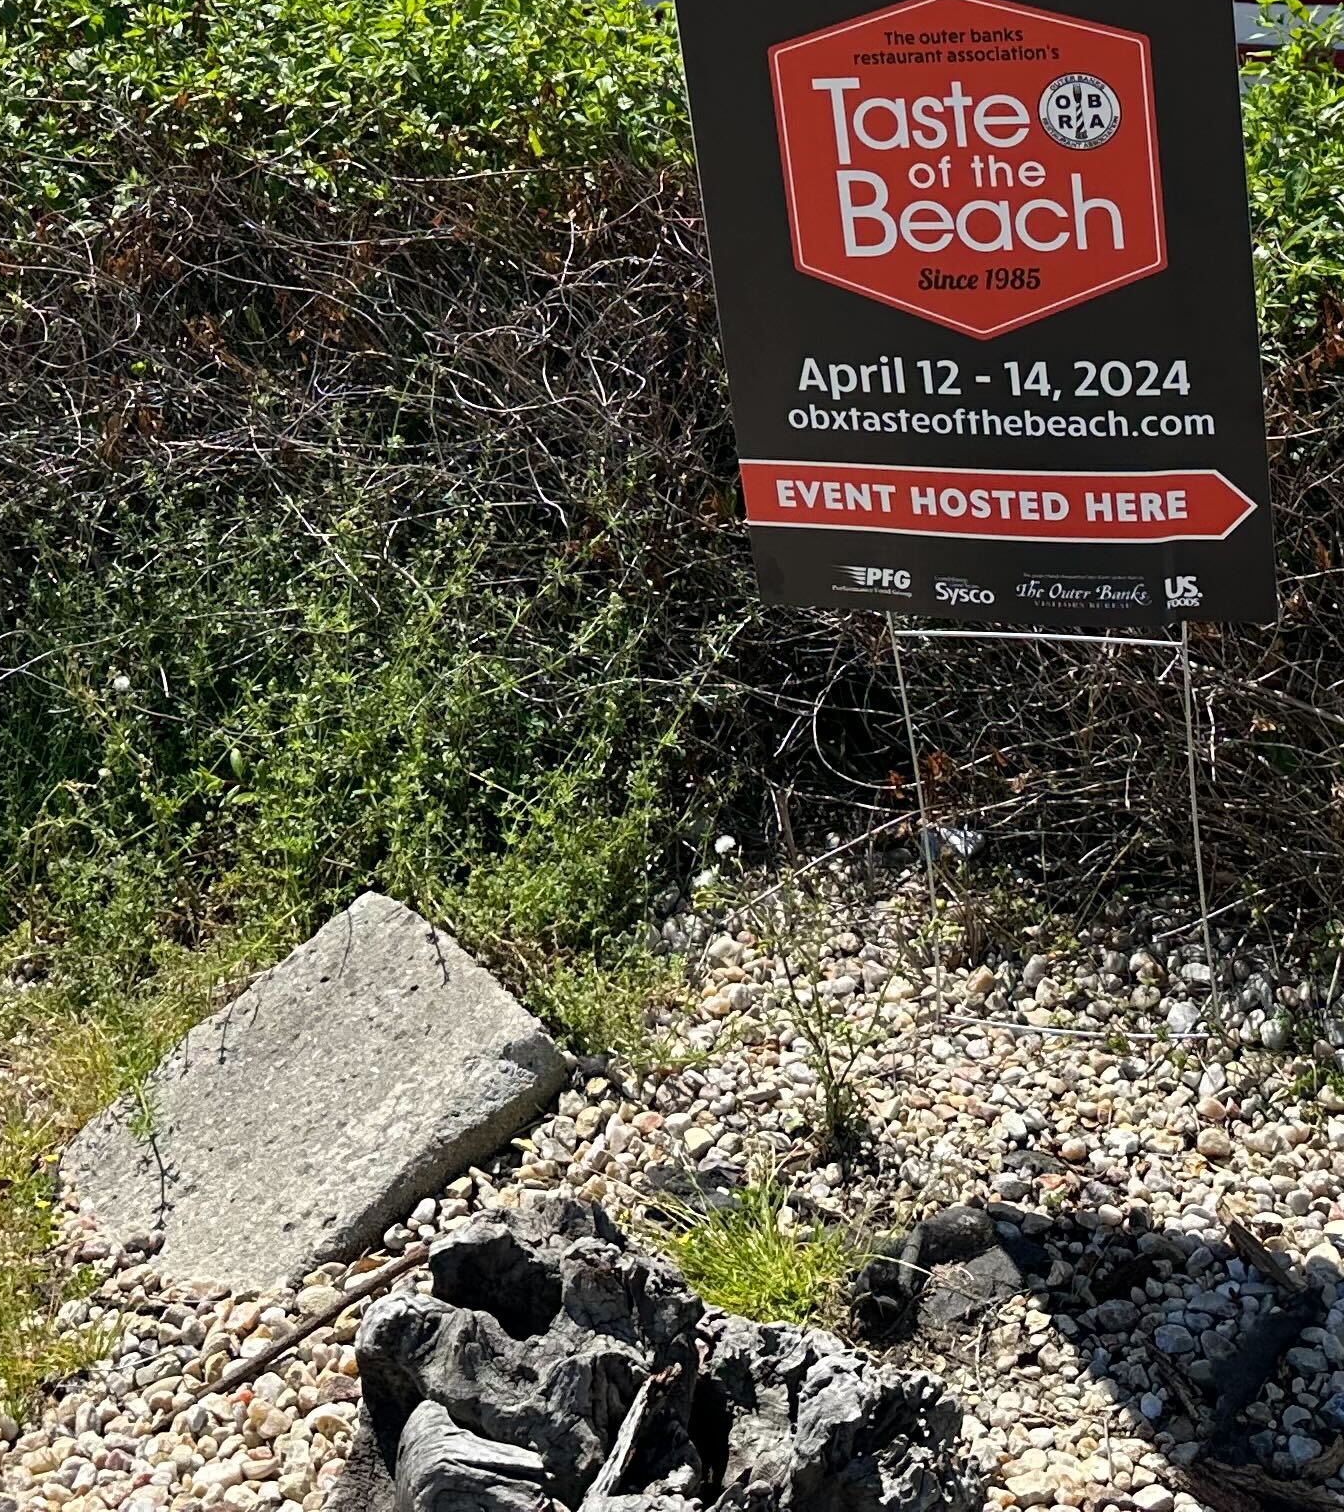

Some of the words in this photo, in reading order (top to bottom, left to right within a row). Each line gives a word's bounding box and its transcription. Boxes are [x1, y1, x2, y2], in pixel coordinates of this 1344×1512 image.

[884, 31, 915, 45] The
[919, 31, 966, 45] outer
[971, 28, 1024, 44] banks
[853, 49, 943, 65] restaurant
[947, 45, 1059, 63] association's
[811, 77, 1031, 165] Taste
[908, 155, 951, 188] of
[971, 154, 1046, 188] the
[836, 169, 1124, 257] Beach
[918, 267, 979, 290] Since
[984, 267, 1041, 290] 1985
[798, 355, 905, 400] April
[916, 359, 962, 396] 12
[1003, 361, 1061, 402] 14,
[1073, 360, 1191, 397] 2024
[788, 404, 1215, 437] obxtasteofthebeach.com
[776, 479, 896, 513] EVENT
[911, 486, 1070, 520] HOSTED
[1085, 491, 1188, 522] HERE
[867, 567, 911, 589] PFG
[935, 582, 995, 605] Sysco
[1016, 580, 1045, 599] The
[1048, 583, 1092, 600] Outer
[1096, 583, 1152, 606] Banks
[1167, 598, 1200, 609] FOODS
